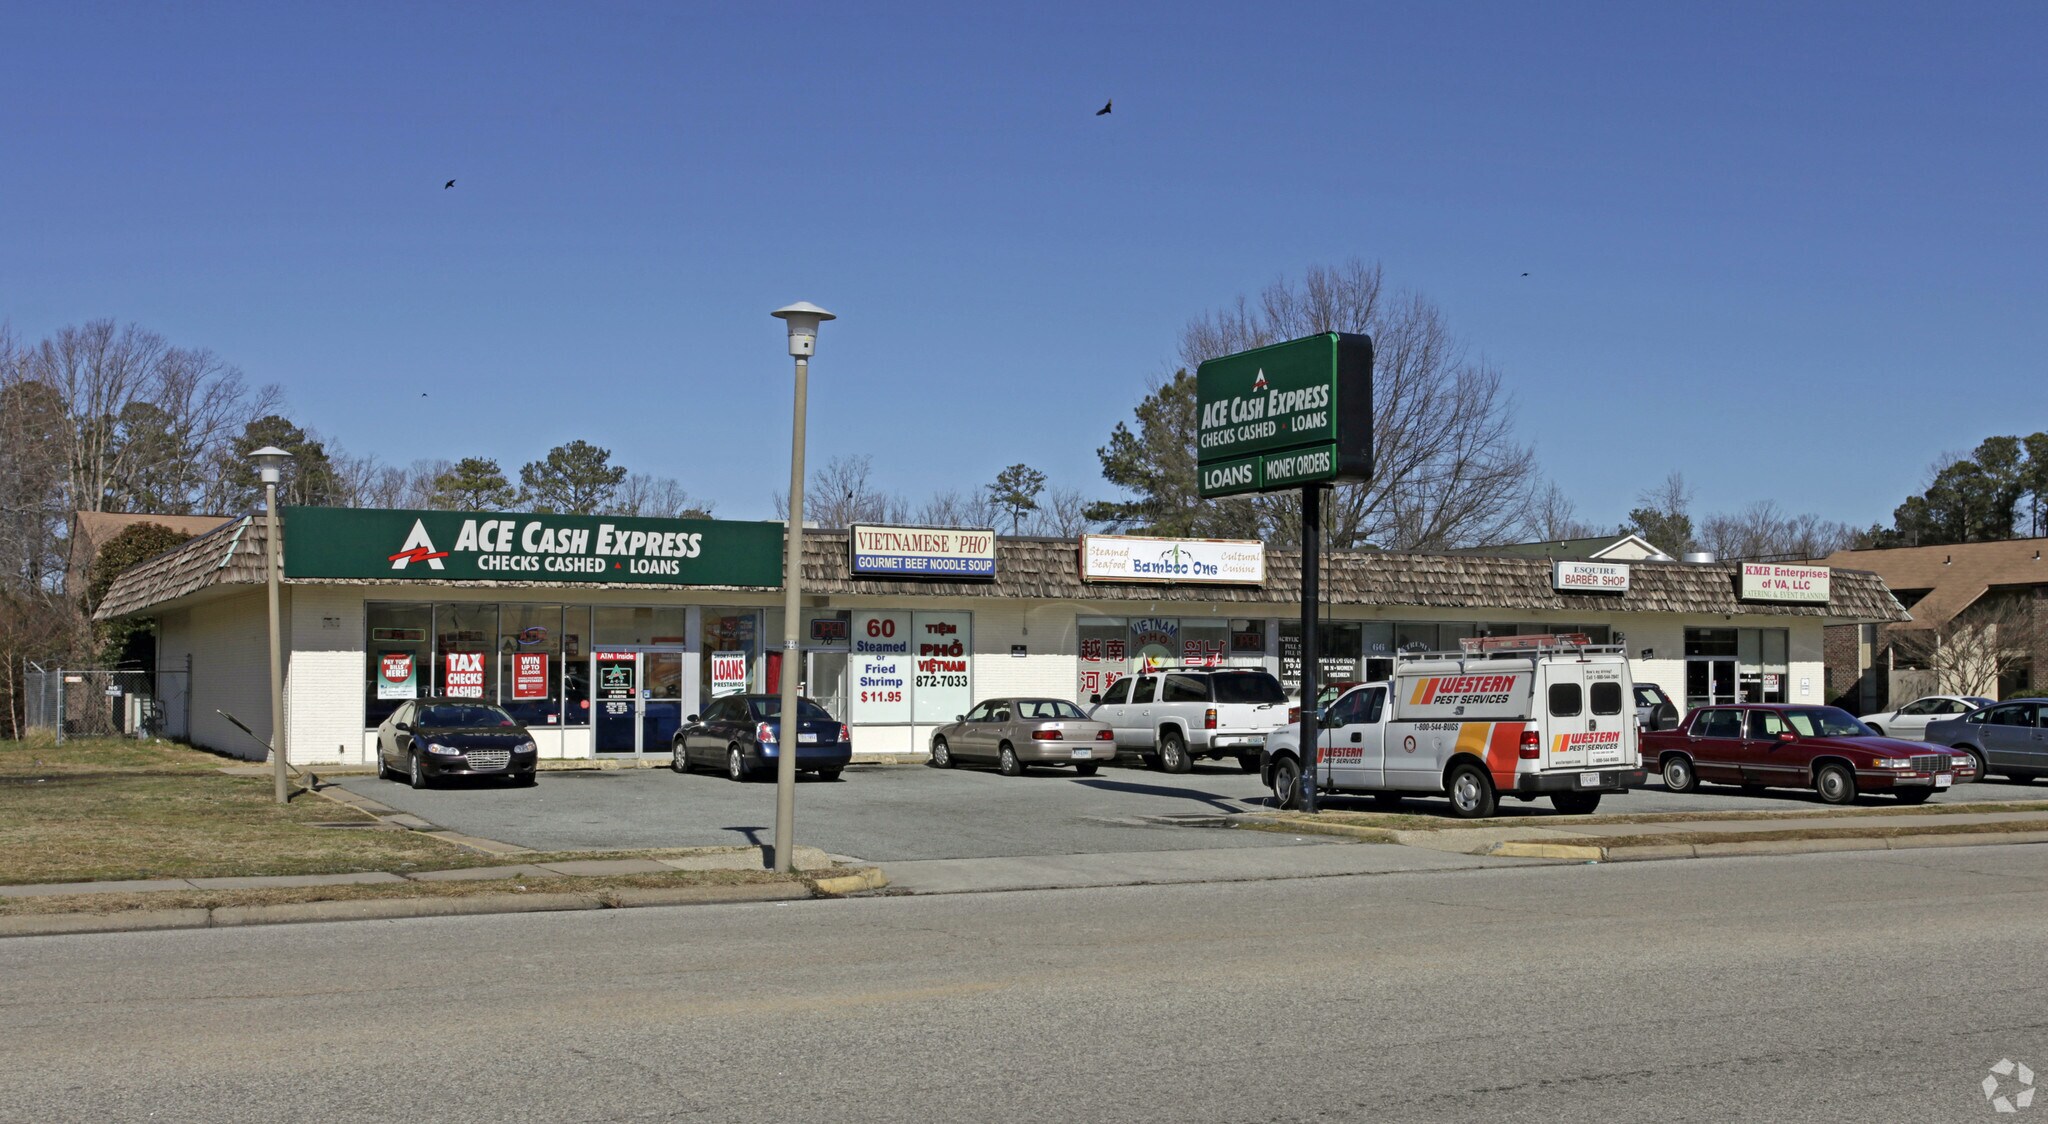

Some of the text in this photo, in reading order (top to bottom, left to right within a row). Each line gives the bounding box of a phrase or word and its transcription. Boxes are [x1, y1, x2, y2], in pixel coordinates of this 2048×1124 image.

[1201, 384, 1329, 430] ACE CASH EXPRESS
[1201, 412, 1327, 448] CHECKS CASHED LOANS
[1267, 452, 1330, 480] MONEY ORDERS
[1205, 464, 1252, 489] LOANS
[454, 520, 702, 558] ACE CASH EXPRESS
[858, 532, 950, 553] VIETNAMESE
[1089, 546, 1260, 561] Steamed Cultural
[478, 554, 680, 575] CHECKS CASHED LOANS
[858, 556, 992, 571] GOURMET BEEF NOODLE SOUP
[1092, 559, 1256, 575] Seafood Bamboo One Cuisine
[1574, 567, 1616, 575] ESQUIRE
[1745, 566, 1828, 579] KMR Enterprises
[1565, 574, 1625, 585] BARBER SHOP
[1762, 580, 1771, 588] of
[1793, 581, 1810, 590] LLC
[815, 622, 844, 636] OPEN
[867, 619, 895, 638] 60
[1131, 618, 1178, 638] VIETNAM
[1141, 633, 1168, 644] PHO
[857, 641, 906, 652] Steamed
[1081, 640, 1125, 661] 越南
[448, 653, 482, 671] TAX
[865, 664, 896, 674] Fried
[386, 669, 408, 677] HERE!
[714, 660, 744, 680] LOANS
[448, 673, 482, 684] CHECKS
[860, 677, 903, 688] Shrimp
[916, 676, 968, 687] 872-7033
[1439, 675, 1516, 693] WESTERN
[447, 686, 482, 698] CASHED
[861, 691, 901, 703] $11.95
[1434, 694, 1509, 704] PEST SERVICES
[1572, 732, 1620, 744] WESTERN
[1324, 748, 1363, 757] WESTERN
